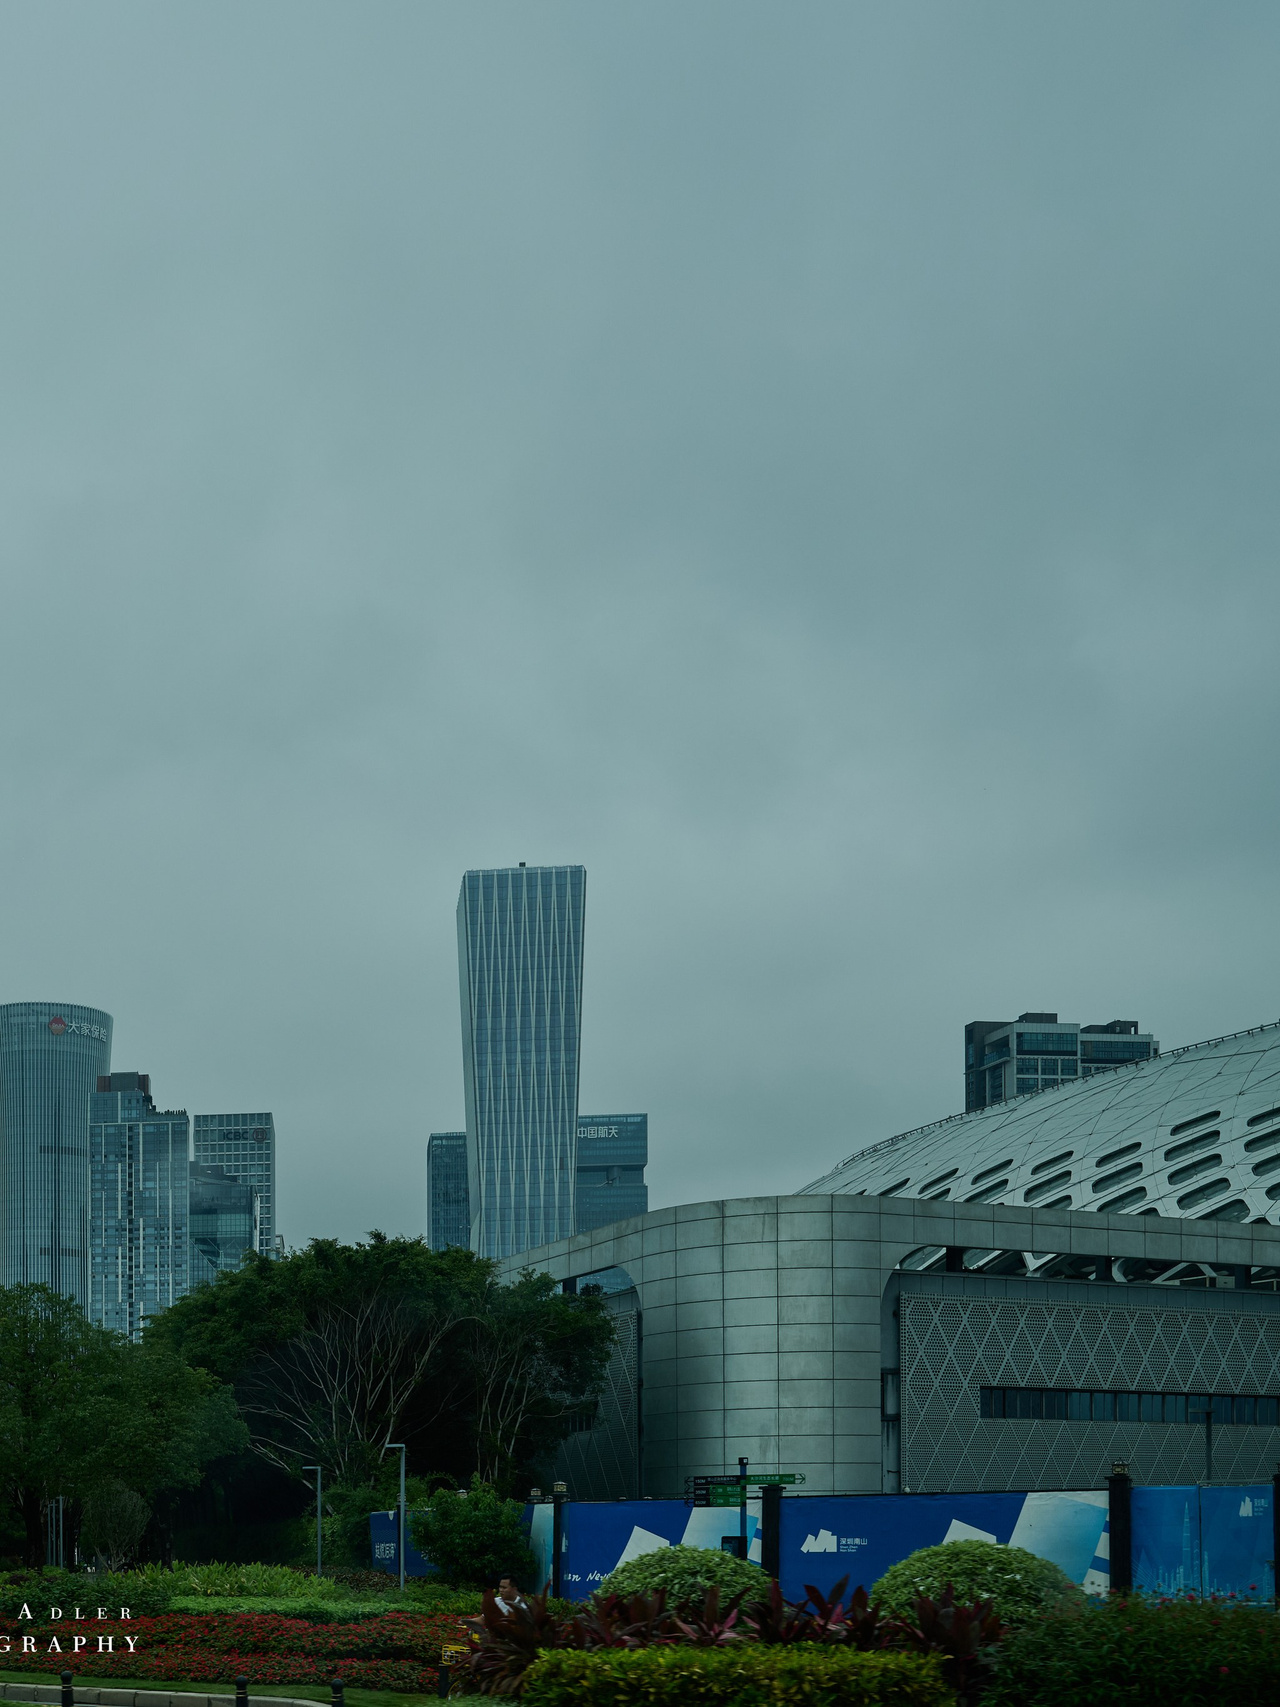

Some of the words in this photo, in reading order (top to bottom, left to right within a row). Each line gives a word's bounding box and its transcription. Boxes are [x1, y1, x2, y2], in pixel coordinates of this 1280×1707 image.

[68, 1021, 107, 1042] 大家保险
[223, 1131, 249, 1141] ICBC
[577, 1126, 618, 1138] 中国航天
